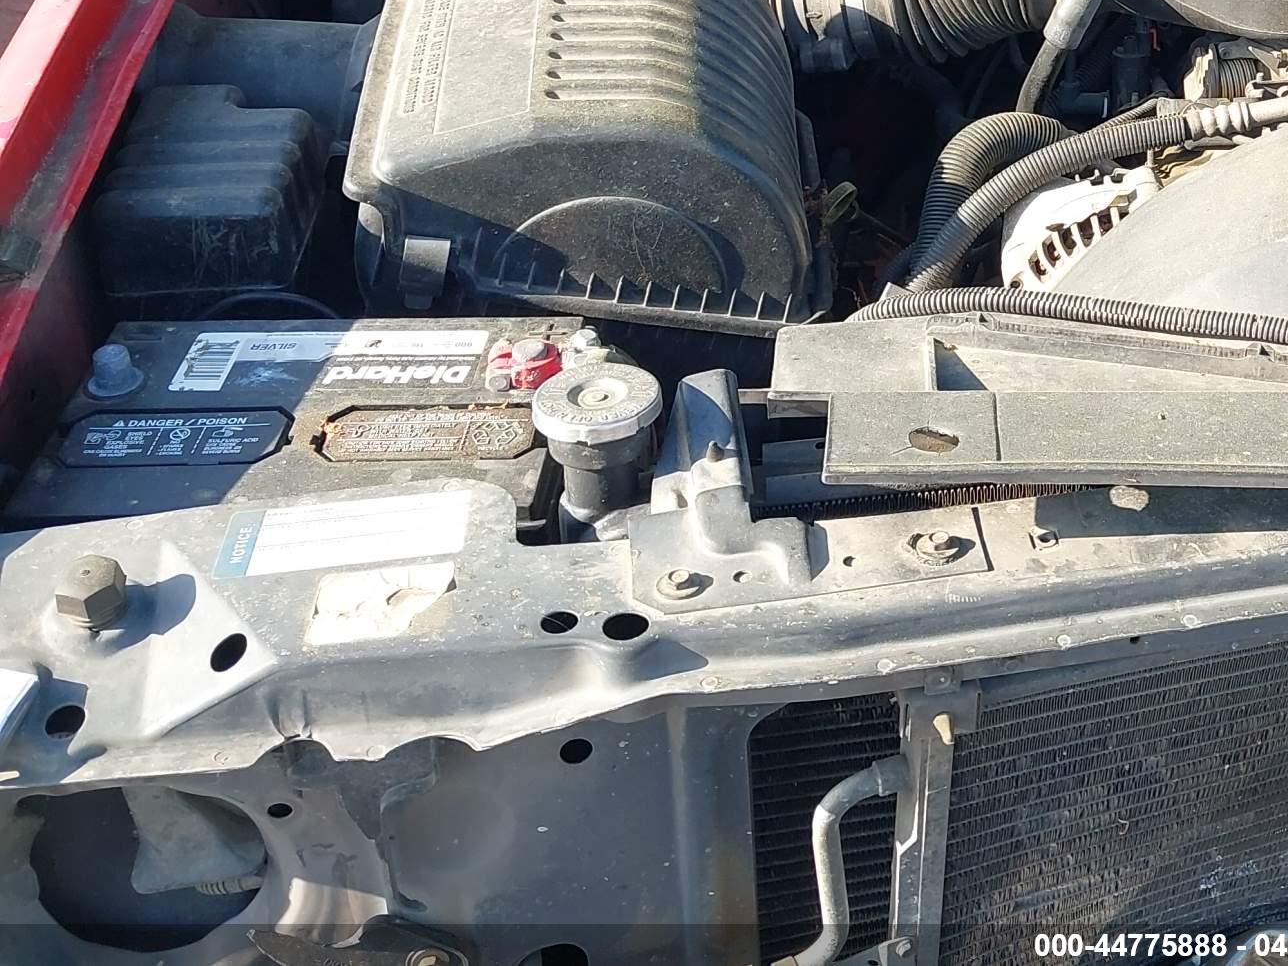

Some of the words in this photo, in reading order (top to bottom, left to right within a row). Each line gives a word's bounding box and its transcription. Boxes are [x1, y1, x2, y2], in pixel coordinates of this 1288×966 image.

[250, 341, 297, 352] SILVER
[321, 365, 472, 385] DieHard
[127, 419, 184, 427] DANGER
[197, 417, 248, 425] POISON
